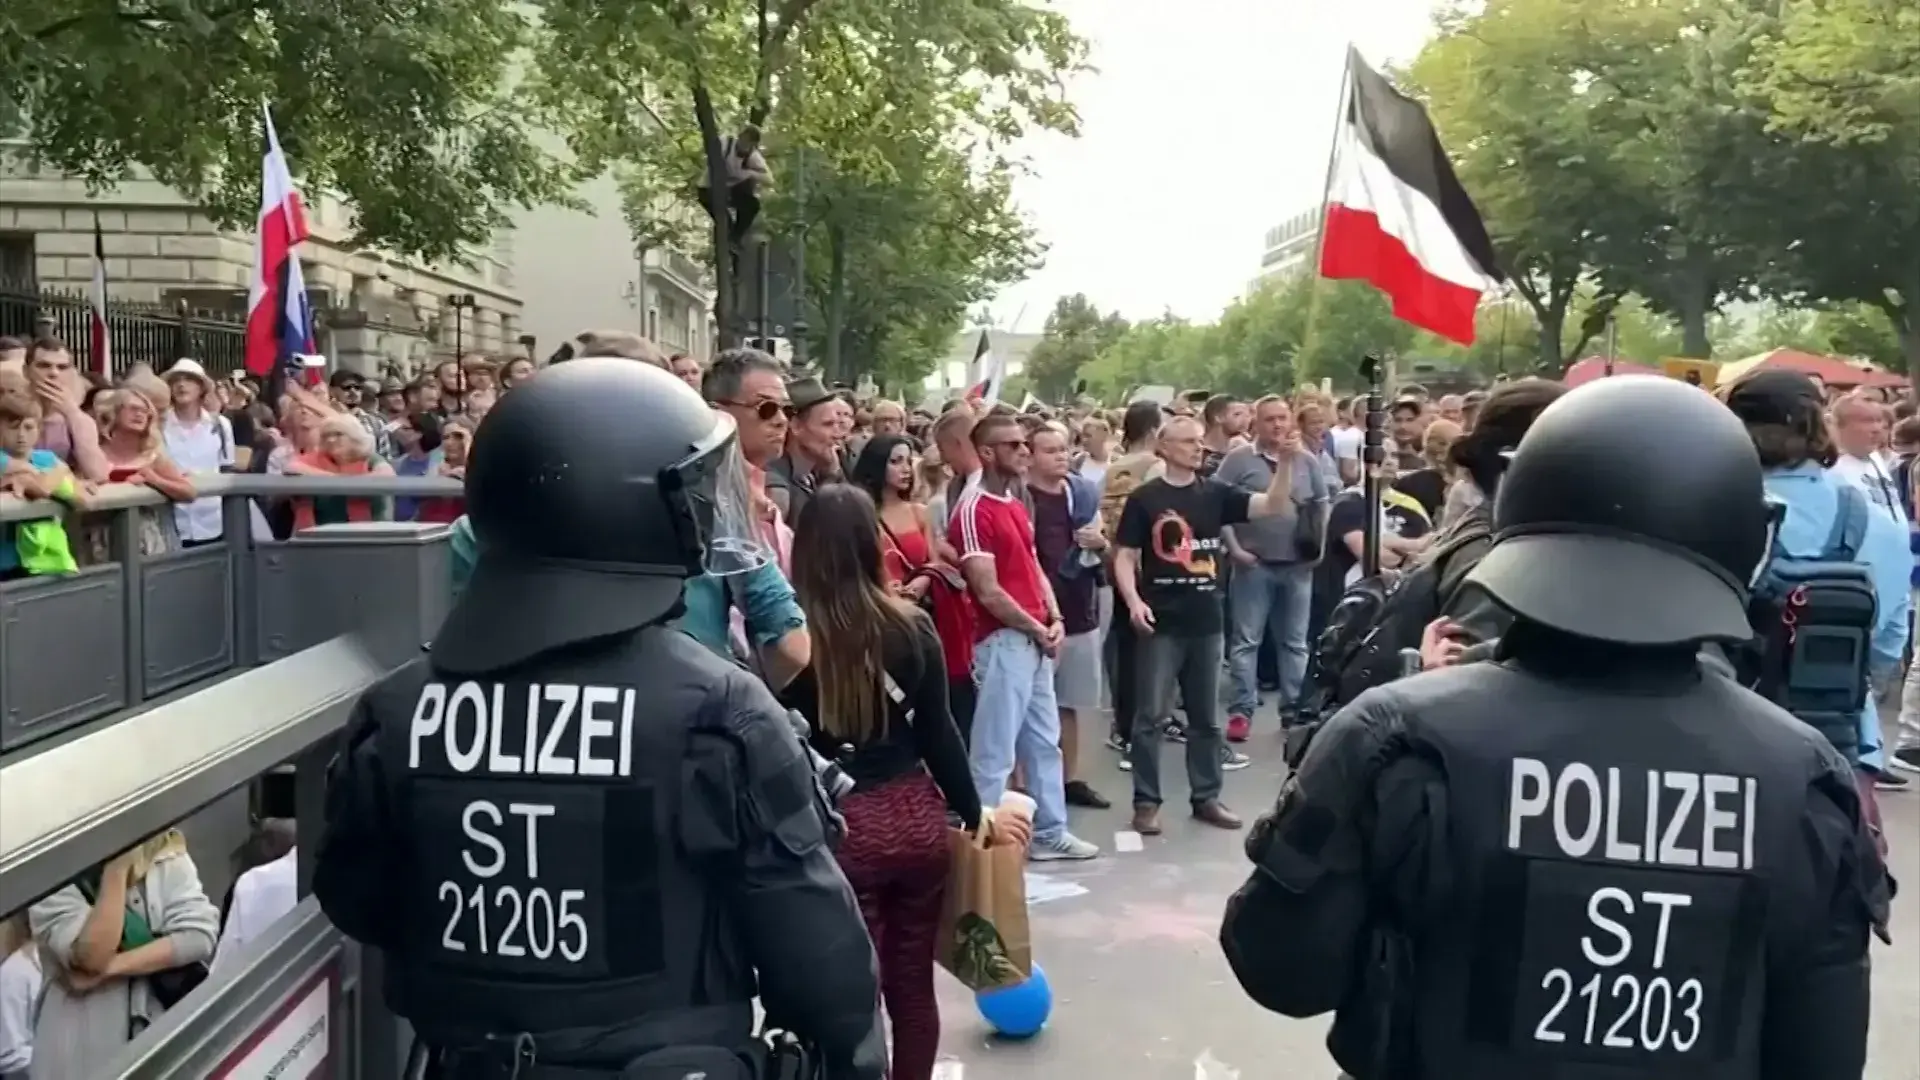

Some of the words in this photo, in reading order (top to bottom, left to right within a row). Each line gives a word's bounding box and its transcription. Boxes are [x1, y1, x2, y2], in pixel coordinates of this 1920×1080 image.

[409, 681, 636, 776] POLIZEI
[462, 800, 555, 878] ST
[1508, 757, 1757, 869] POLIZEI
[438, 880, 588, 962] 21205
[1581, 887, 1692, 969] ST
[1534, 968, 1703, 1052] 21203
